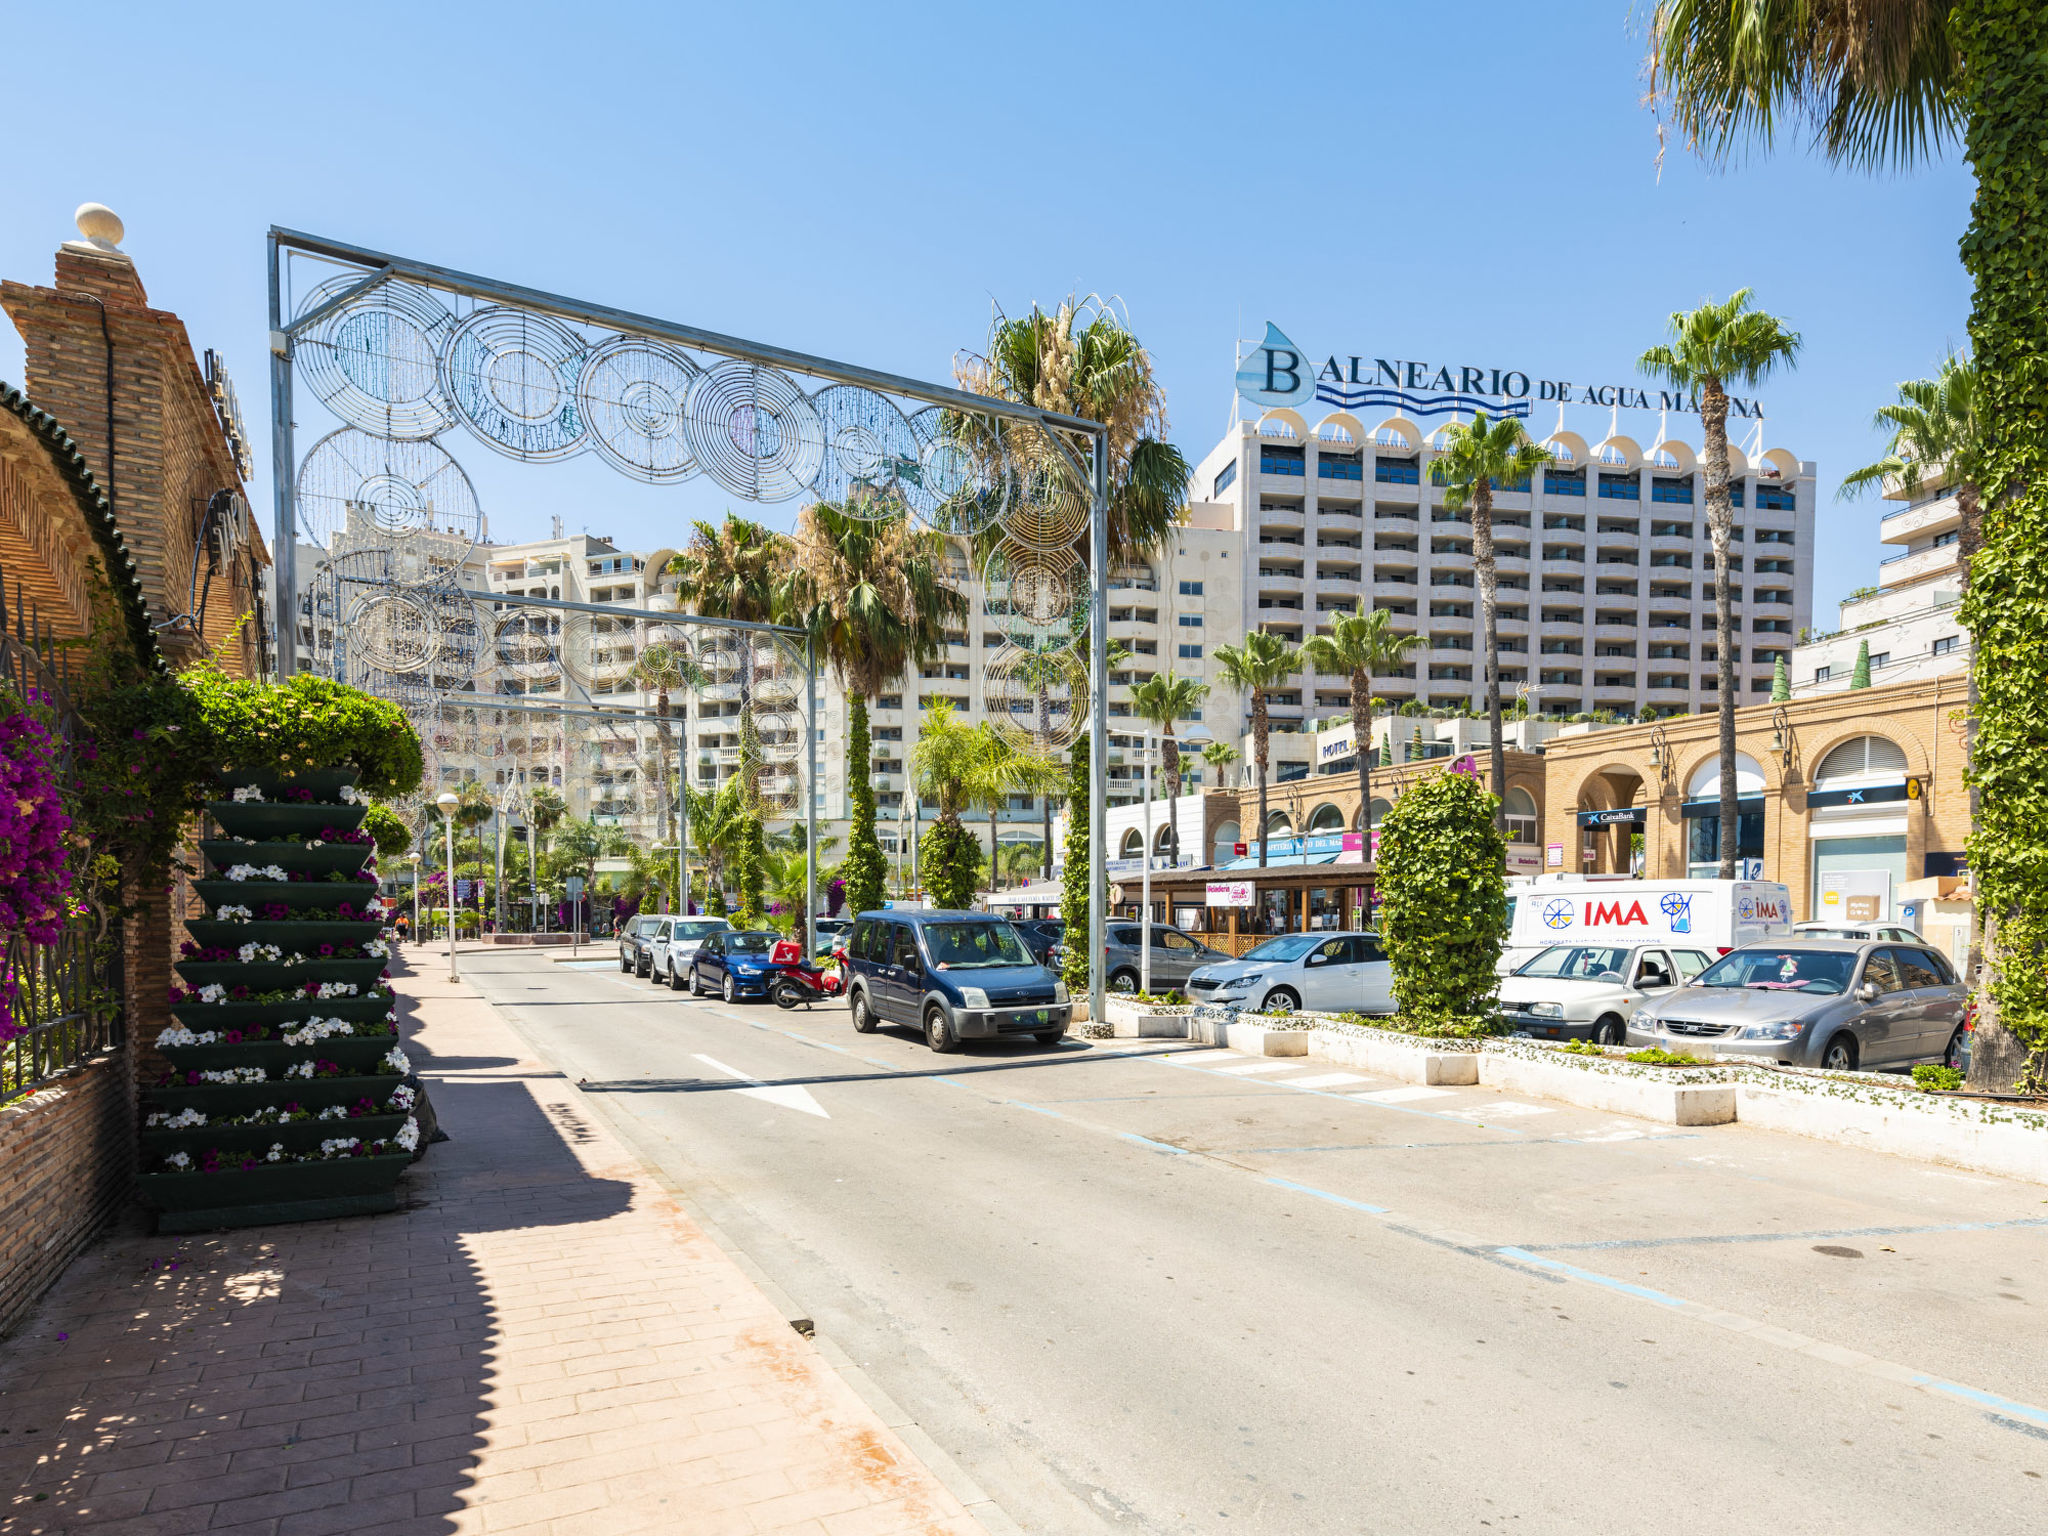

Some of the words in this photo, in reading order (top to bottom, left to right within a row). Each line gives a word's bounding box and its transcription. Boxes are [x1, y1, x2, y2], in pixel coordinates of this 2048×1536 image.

[1260, 349, 1531, 399] BALNEARIO
[1540, 380, 1572, 402] DE
[1581, 385, 1649, 409] AGUA
[1660, 390, 1764, 419] MANA
[1323, 740, 1349, 758] HOTEL
[1600, 812, 1635, 821] CaixaBank
[1584, 900, 1649, 926] IMA
